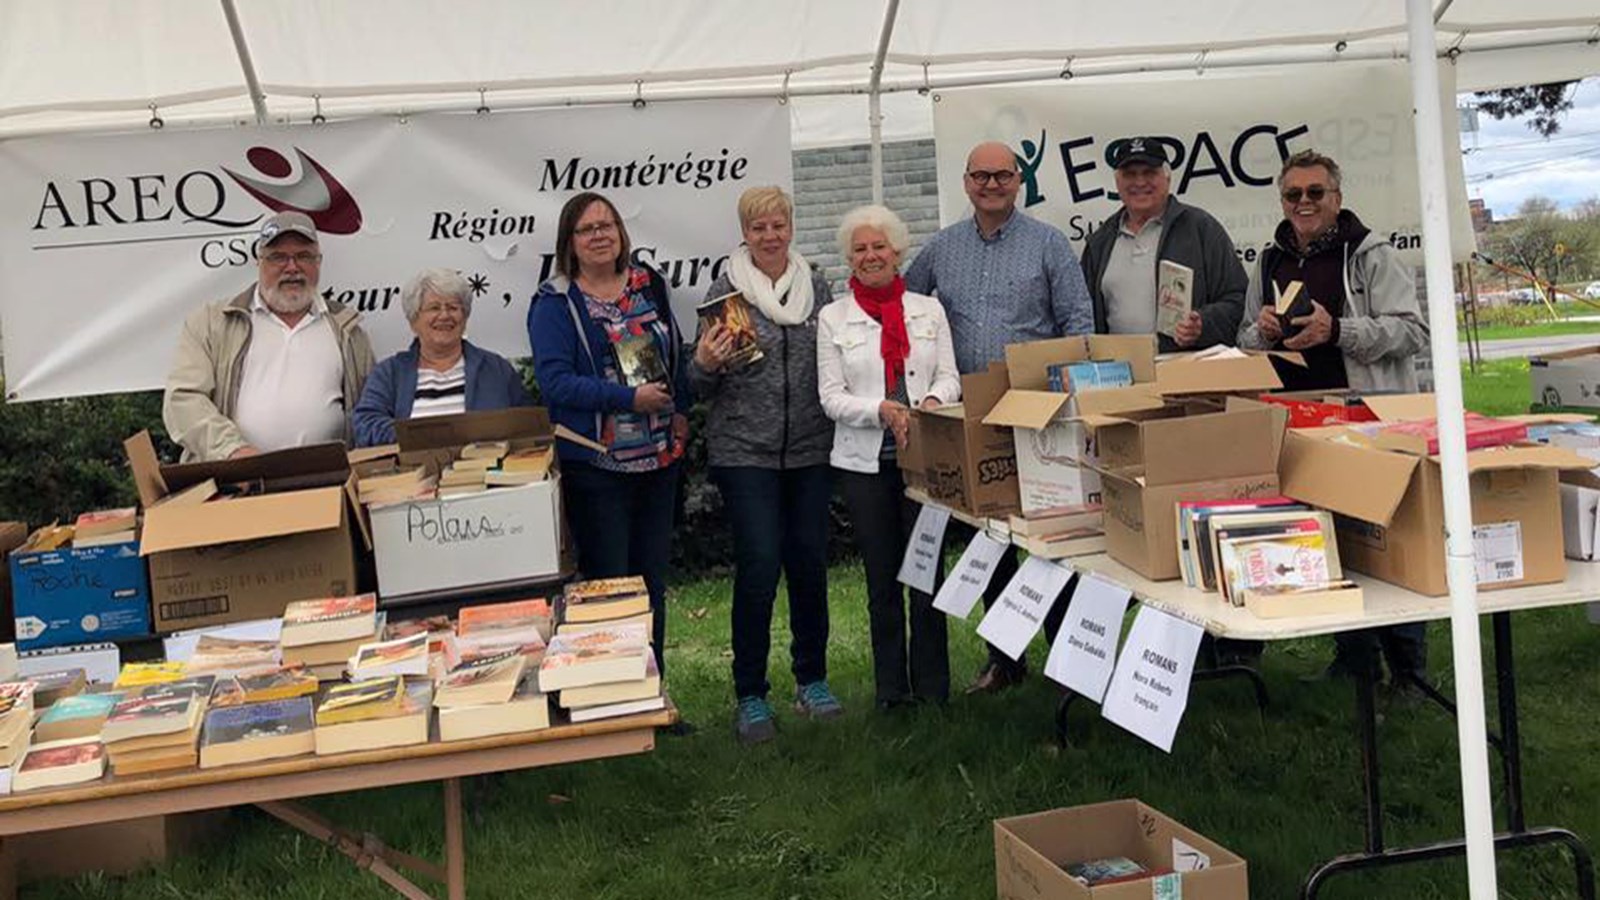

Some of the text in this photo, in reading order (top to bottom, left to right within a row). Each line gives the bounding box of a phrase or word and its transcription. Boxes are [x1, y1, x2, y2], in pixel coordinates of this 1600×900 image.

[538, 149, 748, 192] Montérégie
[33, 171, 265, 231] AREQ
[429, 210, 535, 243] Région
[1080, 618, 1106, 637] ROMANS
[1142, 649, 1178, 674] ROMANS
[1132, 671, 1173, 696] Nora Roberts
